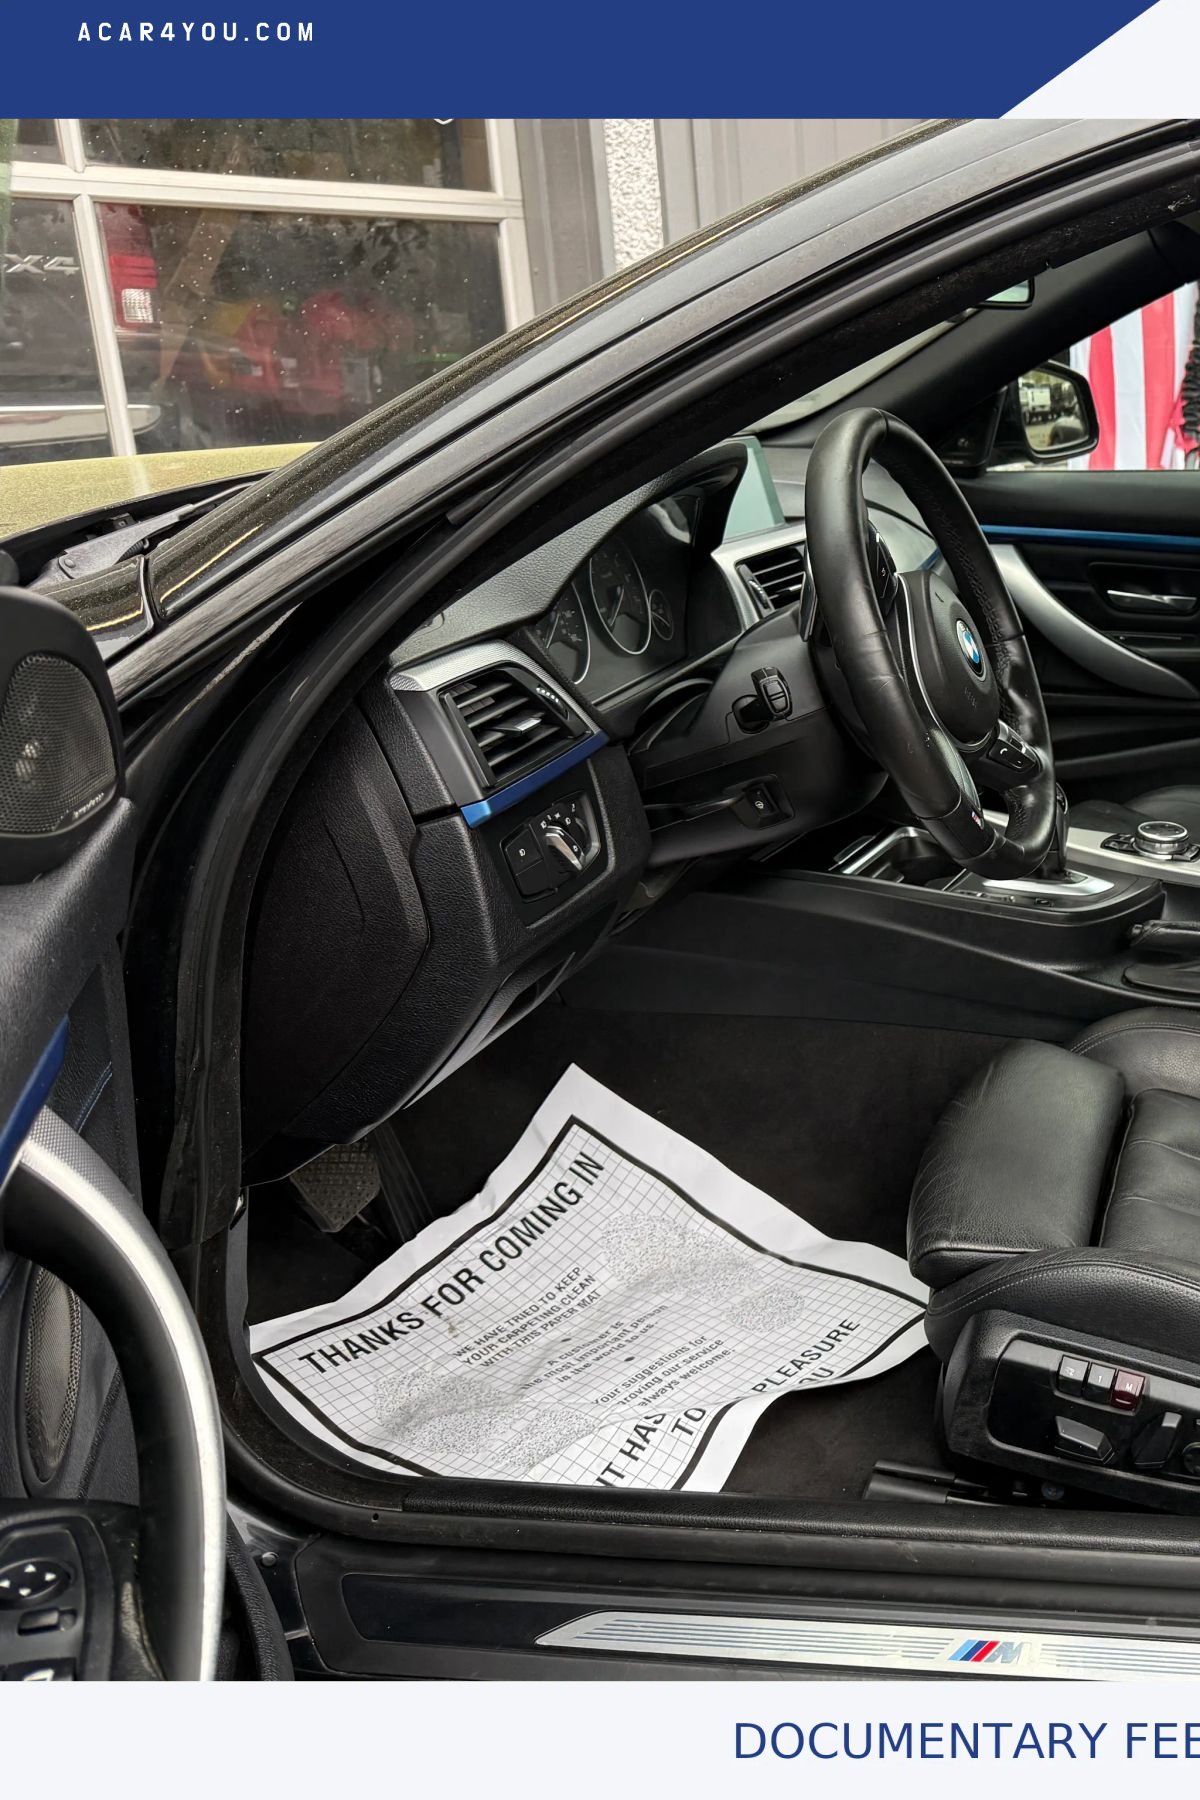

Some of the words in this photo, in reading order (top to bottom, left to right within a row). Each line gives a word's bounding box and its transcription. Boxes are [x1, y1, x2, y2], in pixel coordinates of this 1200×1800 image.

[296, 1307, 426, 1373] THANKS
[418, 1265, 485, 1317] FOR
[477, 1178, 584, 1271] COMING
[569, 1151, 606, 1187] IN
[451, 1345, 475, 1356] WE
[472, 1325, 507, 1345] HAVE
[504, 1303, 541, 1327] TRIED
[537, 1289, 557, 1306] TO
[554, 1265, 583, 1293] KEEP
[461, 1342, 498, 1365] YOUR
[497, 1302, 561, 1344] CARPETING
[559, 1274, 596, 1306] CLEAN
[479, 1345, 514, 1368] WITH
[511, 1328, 541, 1348] THIS
[539, 1305, 579, 1331] PAPER
[575, 1288, 601, 1310] MAT
[541, 1360, 575, 1379] most
[574, 1326, 631, 1363] important
[629, 1302, 668, 1330] person
[546, 1357, 559, 1366] A
[558, 1328, 611, 1359] customer
[609, 1318, 624, 1331] is
[556, 1373, 571, 1383] in
[570, 1360, 593, 1375] the
[591, 1340, 626, 1362] world
[623, 1332, 640, 1344] to
[591, 1386, 622, 1408] Your
[620, 1342, 691, 1390] suggestions
[688, 1334, 707, 1348] for
[618, 1413, 667, 1460] HAS
[751, 1318, 861, 1391] PLEASURE
[635, 1376, 681, 1408] always
[661, 1361, 682, 1378] our
[681, 1336, 724, 1366] service
[1125, 1383, 1134, 1393] M
[670, 1406, 707, 1435] TO
